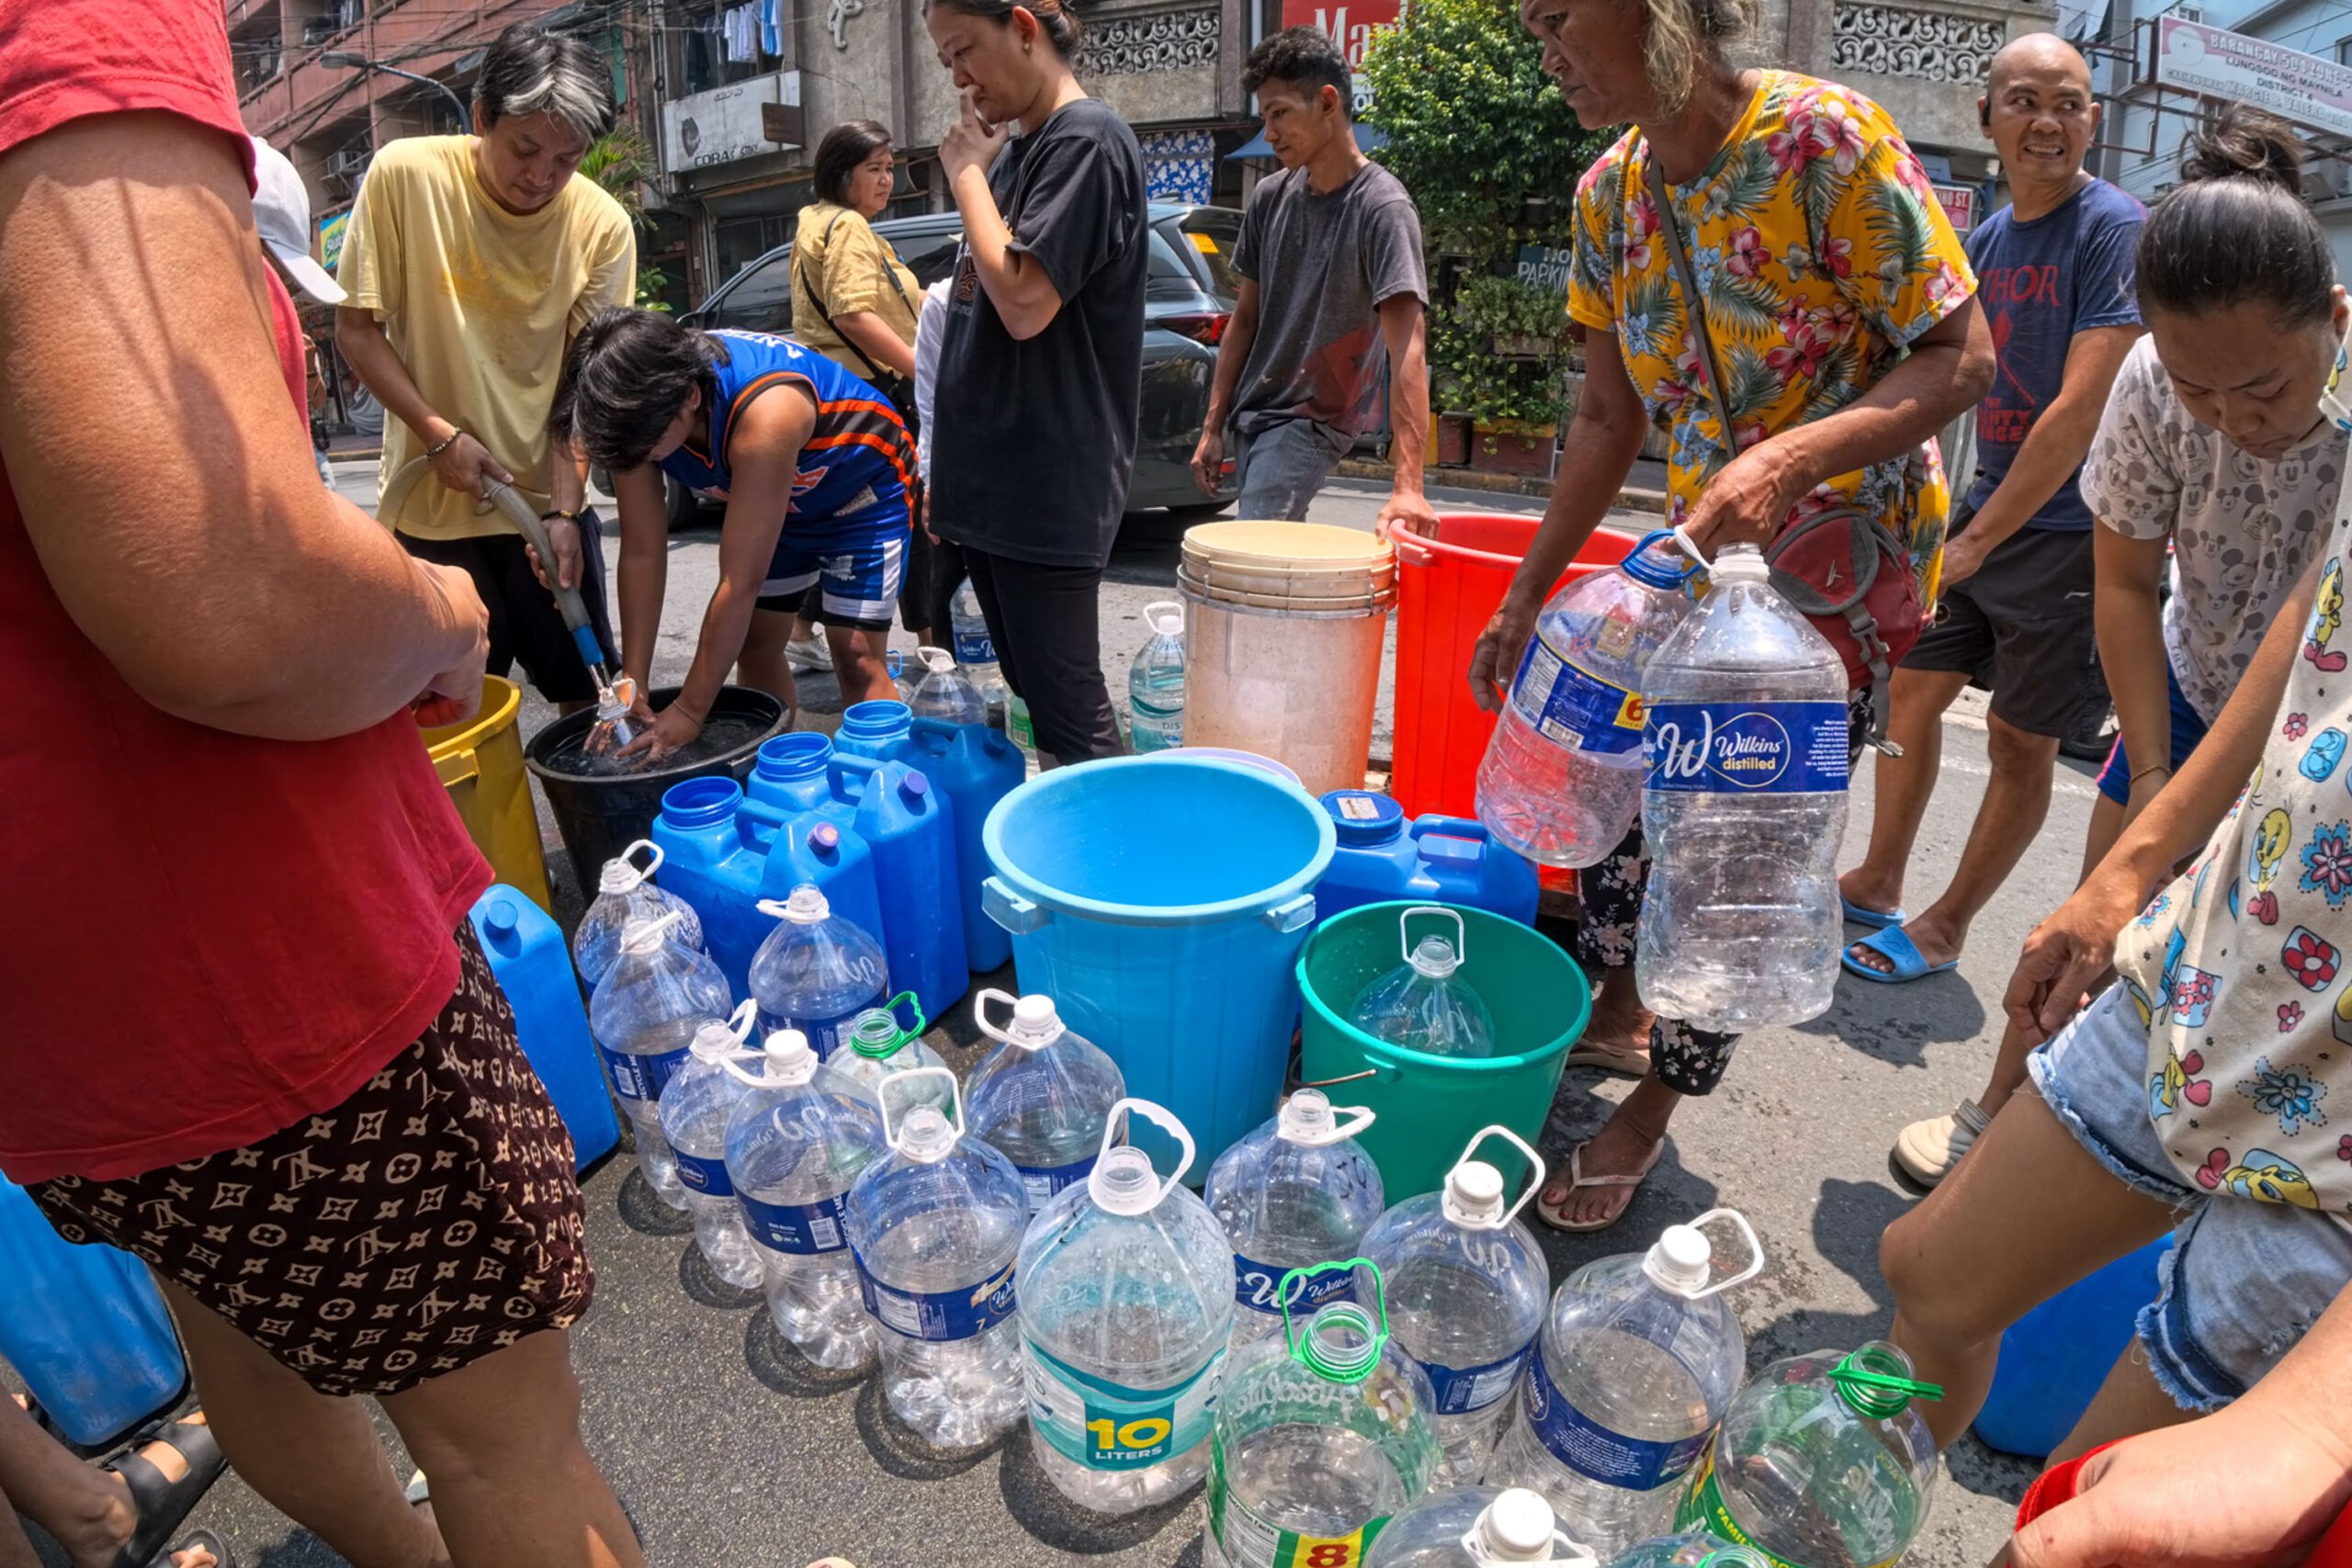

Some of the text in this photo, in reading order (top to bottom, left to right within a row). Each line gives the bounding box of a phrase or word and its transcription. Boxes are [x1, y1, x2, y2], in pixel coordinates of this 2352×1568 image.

[2211, 33, 2278, 66] BARANGAY
[2225, 56, 2344, 98] LUNGSOD NG MAYNILA
[2256, 77, 2304, 98] DISTRICT
[1977, 264, 2063, 309] THOR
[1626, 698, 1643, 721] 6
[1714, 731, 1781, 758] Wilkins
[1722, 757, 1776, 771] distilled
[976, 1317, 987, 1332] 7
[1087, 1417, 1171, 1450] 10
[1095, 1446, 1162, 1461] LITERS
[1716, 1506, 1753, 1549] FAMIL
[1306, 1544, 1350, 1568] 8
